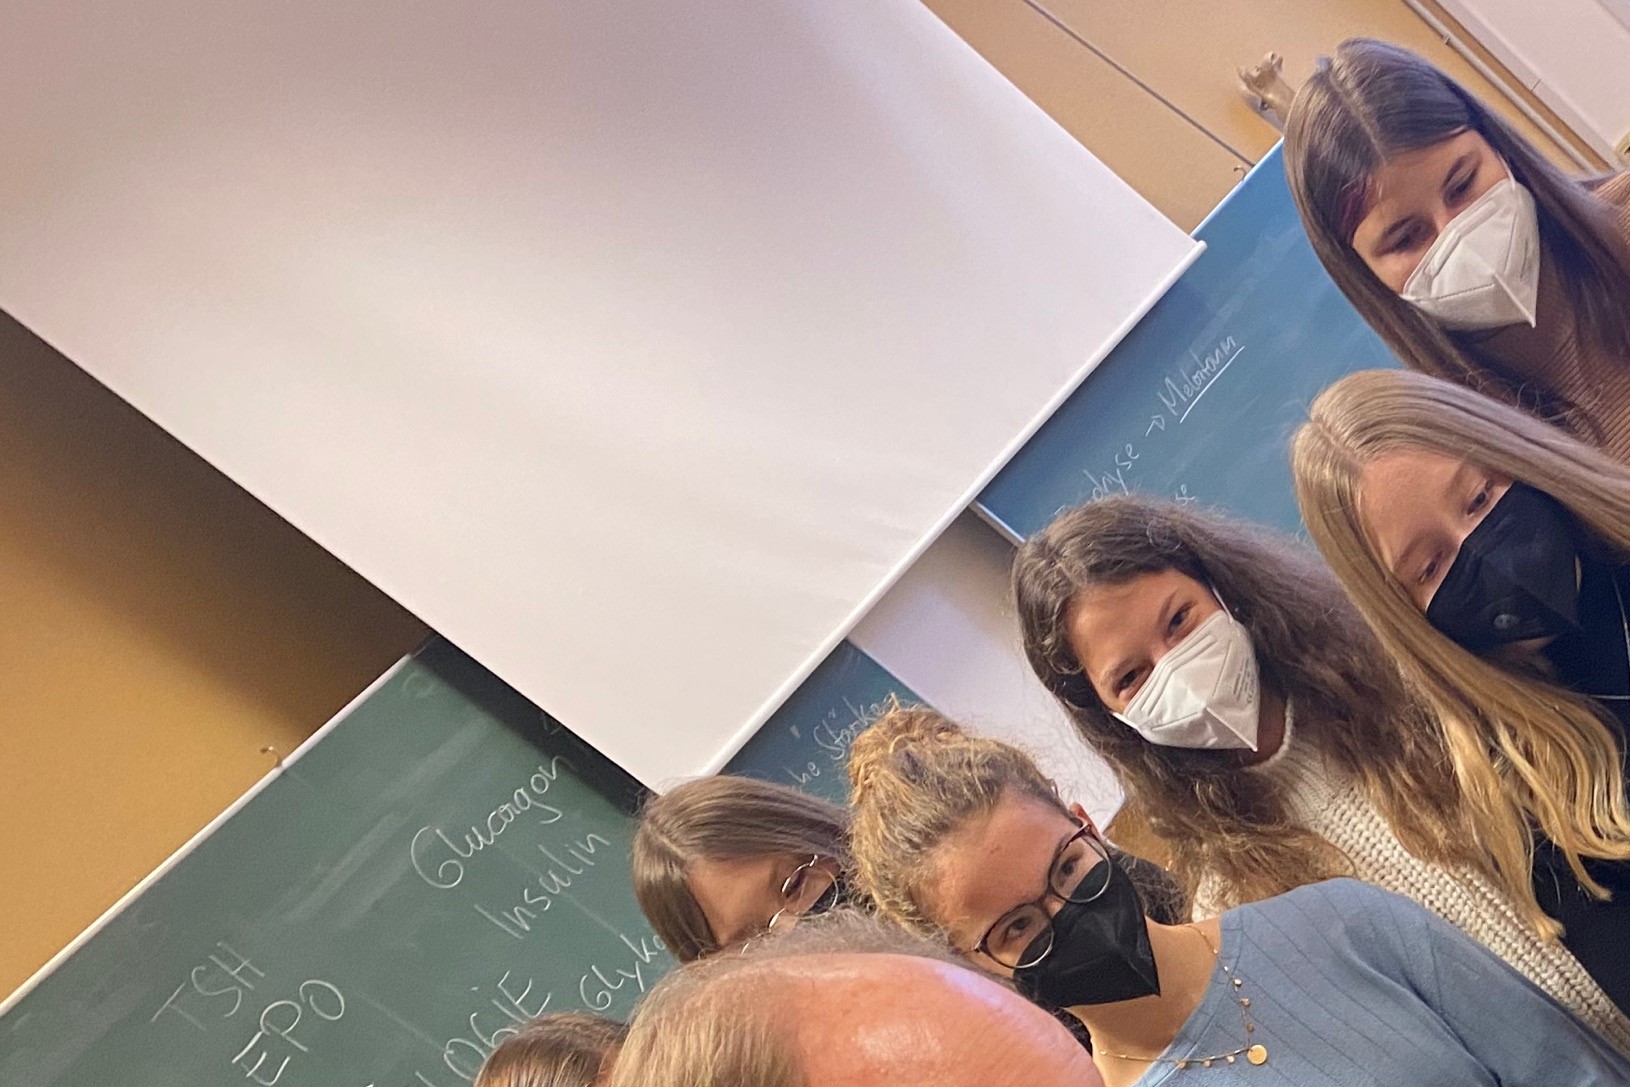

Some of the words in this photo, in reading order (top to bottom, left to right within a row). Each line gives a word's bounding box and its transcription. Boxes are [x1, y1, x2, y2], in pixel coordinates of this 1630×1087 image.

[411, 755, 577, 889] Glucagon
[473, 833, 611, 940] Insulin
[150, 941, 265, 1031] TSH
[580, 934, 666, 1011] Glyko
[231, 979, 345, 1087] EPO
